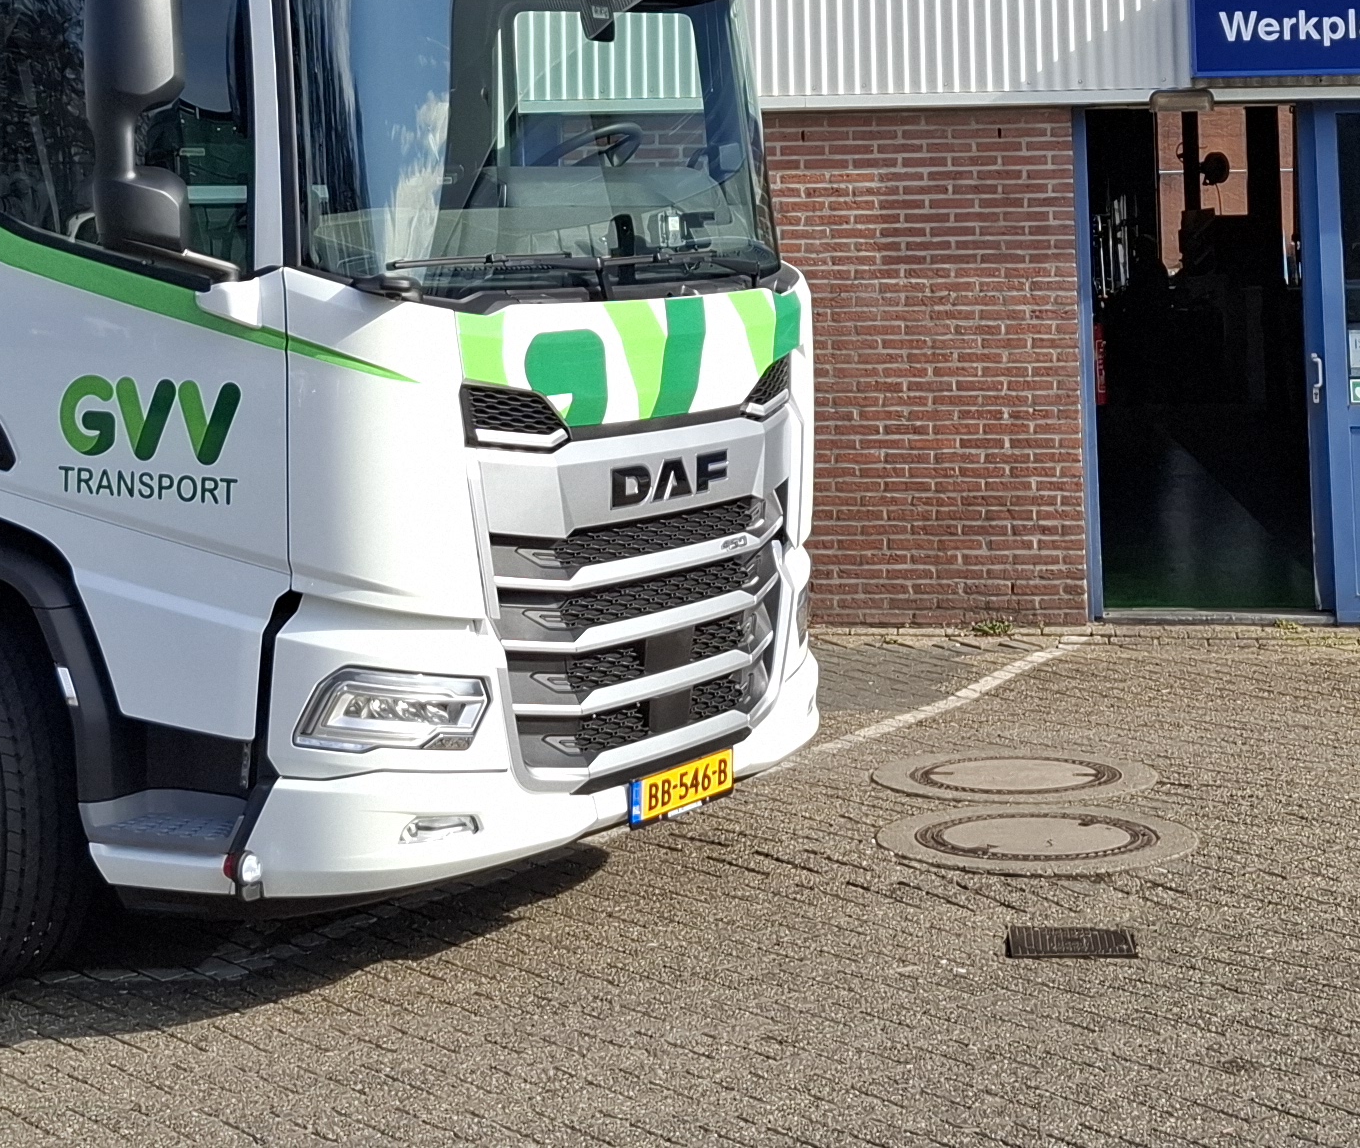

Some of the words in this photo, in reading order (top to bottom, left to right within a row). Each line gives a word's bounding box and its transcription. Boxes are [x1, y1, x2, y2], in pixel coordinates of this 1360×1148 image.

[59, 374, 242, 466] GVV
[58, 465, 239, 506] TRANSPORT
[609, 449, 729, 511] DAF
[647, 757, 728, 812] BB-546-B
